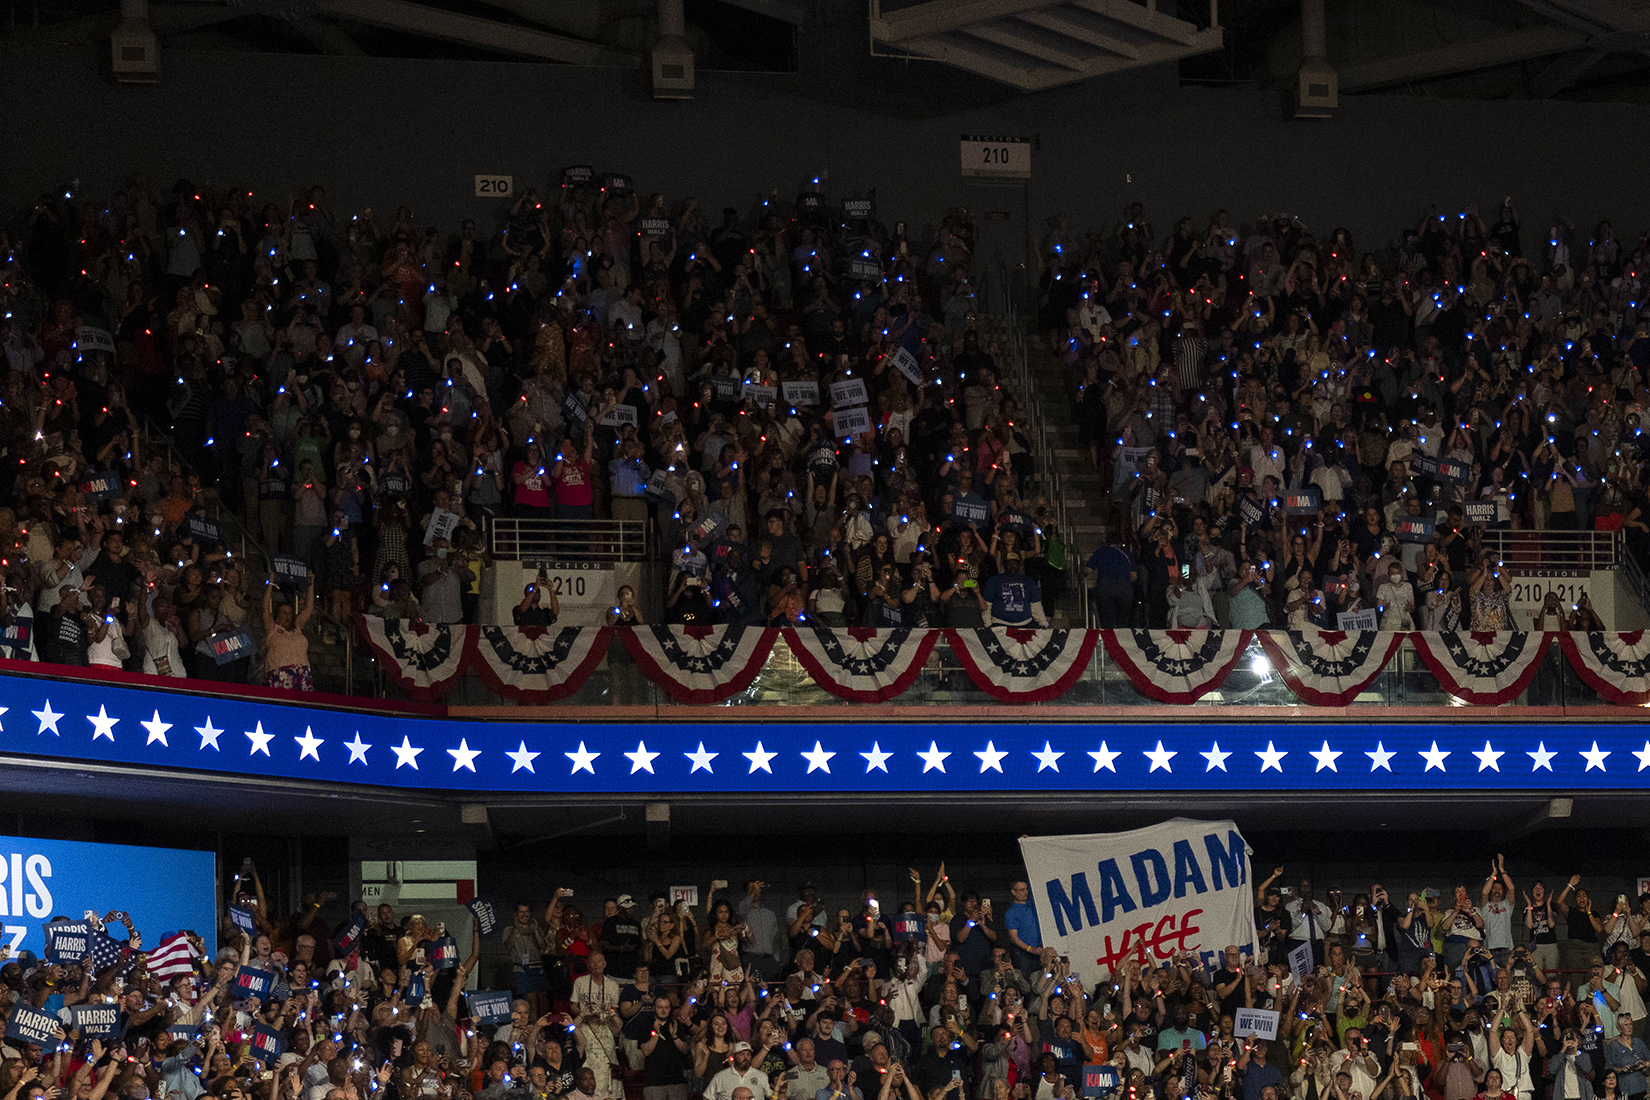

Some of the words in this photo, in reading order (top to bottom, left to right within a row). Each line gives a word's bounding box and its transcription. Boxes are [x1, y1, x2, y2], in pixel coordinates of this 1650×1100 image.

[983, 148, 1009, 164] 210
[480, 180, 507, 192] 210
[845, 201, 871, 211] HARRIS
[643, 220, 669, 230] HARRIS
[956, 506, 967, 518] WE
[969, 508, 987, 520] WIN
[1466, 503, 1494, 516] HARRIS
[274, 561, 288, 575] WE
[289, 563, 307, 577] WIN
[536, 562, 601, 570] SECTION
[1521, 570, 1578, 578] SECTION
[553, 576, 586, 596] 210
[1514, 584, 1539, 602] 210
[1560, 584, 1584, 602] 211
[1342, 621, 1355, 631] WE
[1356, 620, 1373, 630] WIN
[1046, 829, 1247, 937] MADAM
[674, 889, 693, 900] EXIT
[54, 936, 86, 952] HARRIS
[1101, 908, 1204, 977] VICE
[59, 951, 80, 960] WALZ
[475, 1005, 489, 1015] WE
[490, 1001, 510, 1015] WIN
[15, 1008, 59, 1035] HARRIS
[77, 1010, 116, 1025] HARRIS
[1239, 1017, 1253, 1029] WE
[1254, 1019, 1273, 1032] WIN
[26, 1025, 49, 1042] WALZ
[85, 1025, 111, 1034] WALZ
[1086, 1072, 1119, 1089] KAMALA
